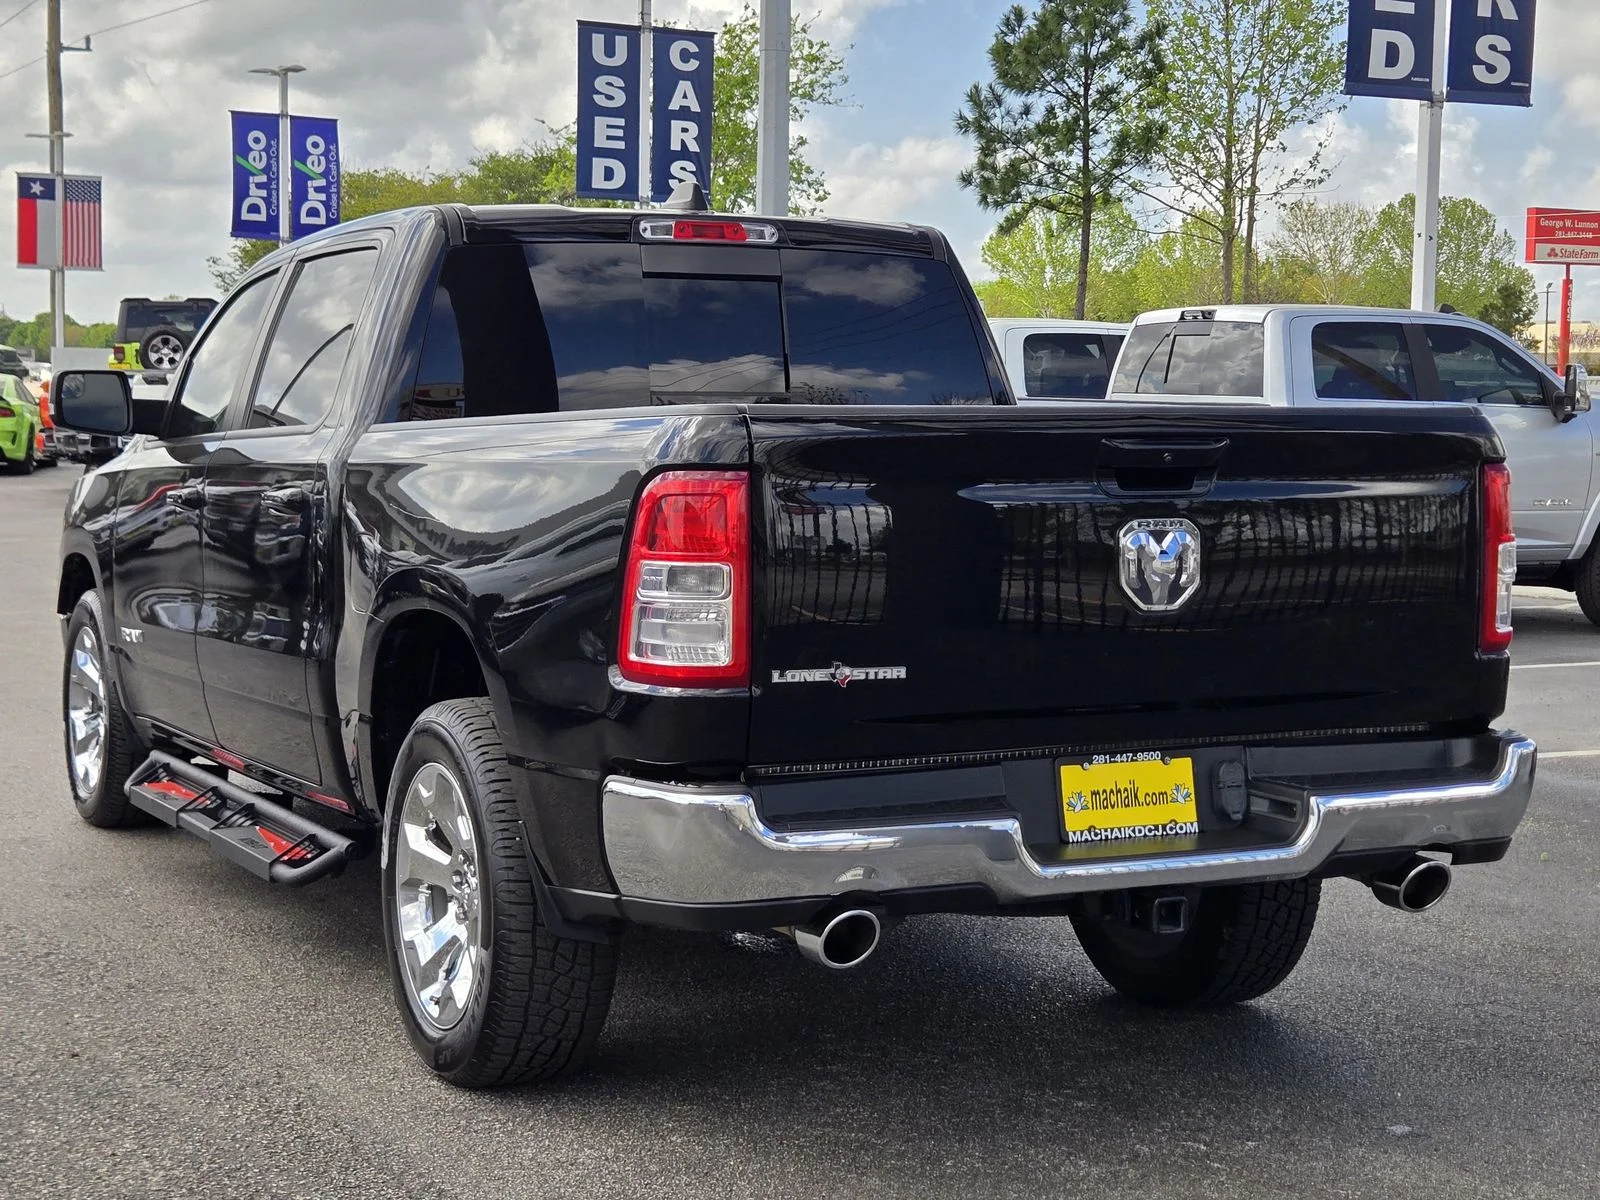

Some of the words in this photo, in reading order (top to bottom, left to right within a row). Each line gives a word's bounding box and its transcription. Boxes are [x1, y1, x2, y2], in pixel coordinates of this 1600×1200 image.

[592, 33, 628, 190] USED
[668, 40, 701, 189] CARS
[329, 161, 337, 182] Cash
[329, 193, 338, 219] Cruise
[1540, 217, 1563, 228] George
[1564, 218, 1573, 228] W.
[1137, 519, 1184, 528] RAM
[771, 668, 832, 683] LONE
[851, 665, 907, 680] STAR
[1092, 751, 1161, 765] 281-447-9500
[1090, 780, 1169, 811] machaik.com
[1068, 821, 1199, 843] MACHAIKDCJ.COM
